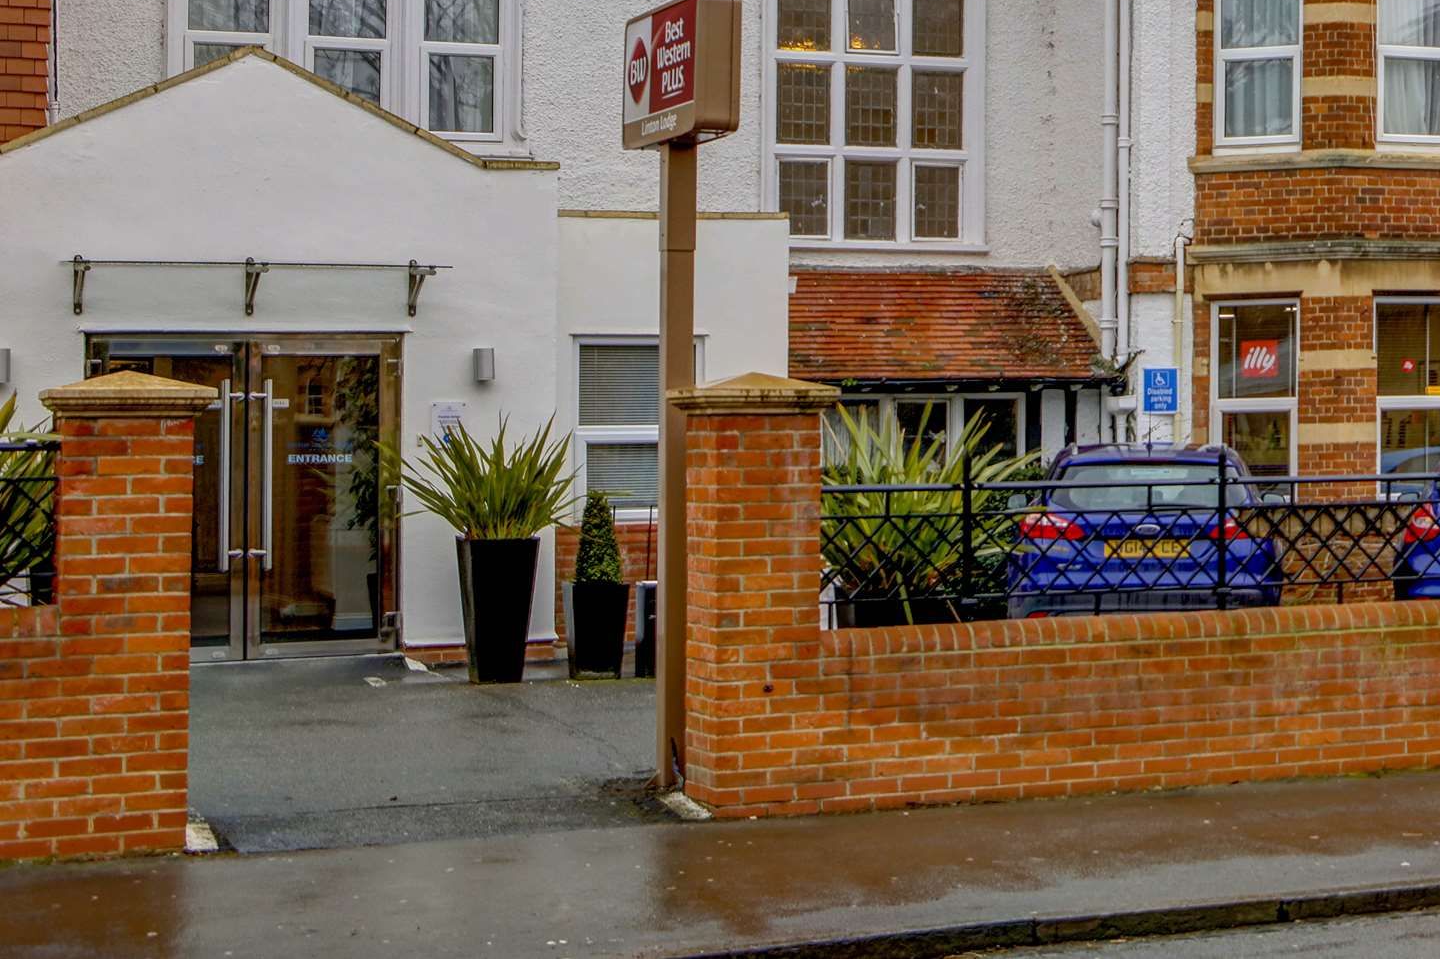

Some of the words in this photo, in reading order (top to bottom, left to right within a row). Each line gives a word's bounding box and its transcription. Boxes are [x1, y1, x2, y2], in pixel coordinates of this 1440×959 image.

[664, 17, 684, 43] Best
[656, 40, 691, 70] Western
[630, 56, 646, 86] BW
[661, 66, 684, 94] PLUS
[660, 112, 678, 132] Lodge
[1243, 346, 1276, 374] illy
[287, 453, 353, 465] ENTRANCE
